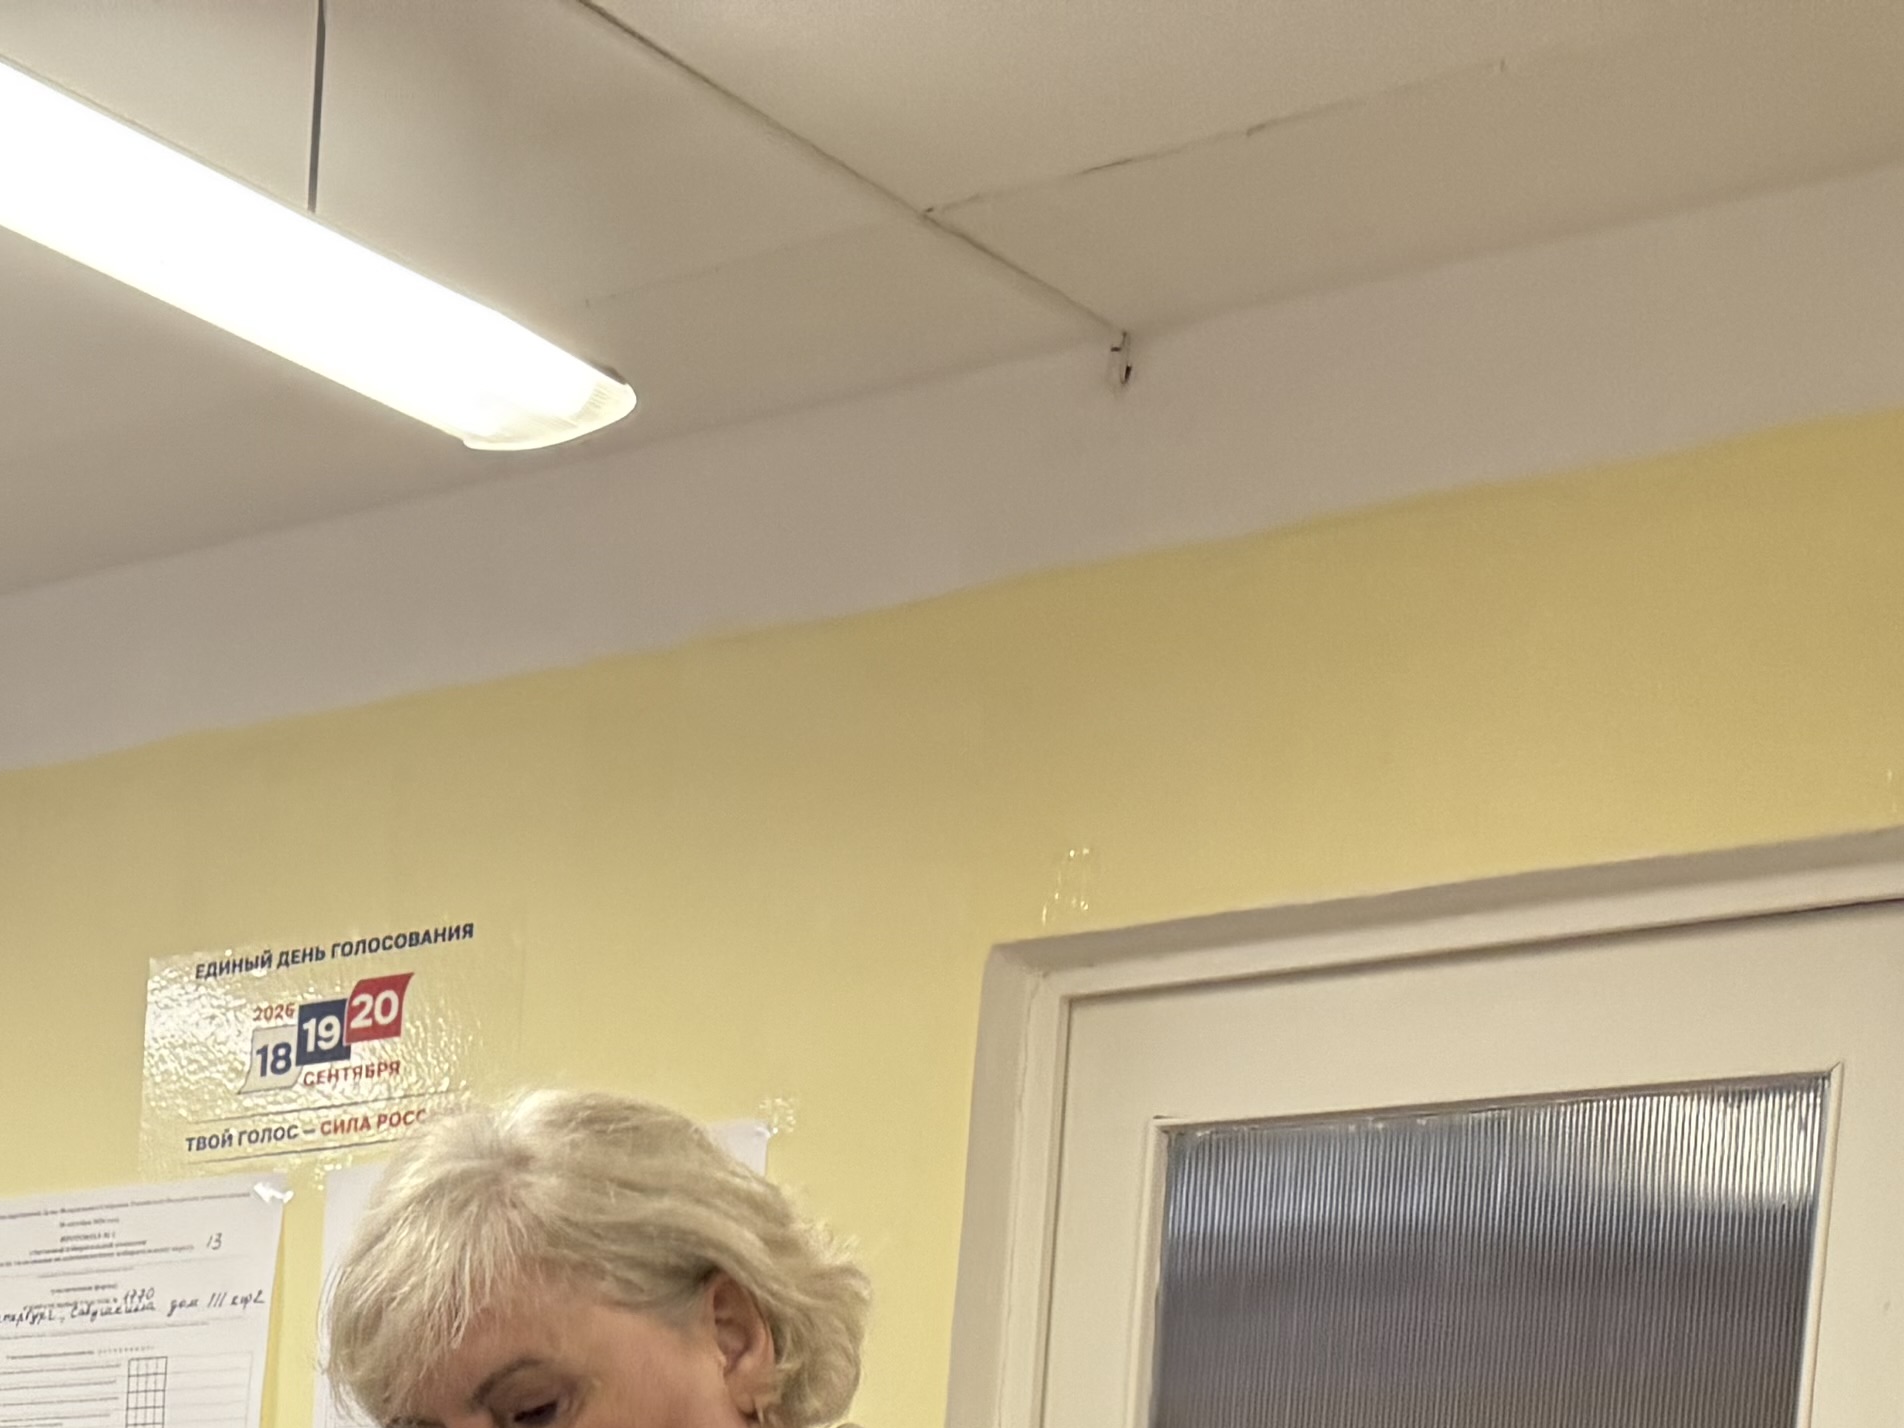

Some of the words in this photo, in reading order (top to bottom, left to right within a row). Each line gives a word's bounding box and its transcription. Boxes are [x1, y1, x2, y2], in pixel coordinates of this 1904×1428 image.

[195, 950, 272, 980] ЕДИНЫЙ
[277, 946, 326, 969] ДЕНЬ
[331, 922, 474, 959] ГОЛОСОВАНИЯ
[253, 1002, 296, 1022] 2026
[256, 1041, 292, 1077] 18
[302, 1014, 341, 1053] 19
[350, 990, 399, 1029] 20
[303, 1060, 401, 1088] СЕНТЯБРЯ
[185, 1127, 233, 1152] ТВОЙ
[238, 1123, 300, 1146] ГОЛОС
[319, 1113, 372, 1136] СИЛА
